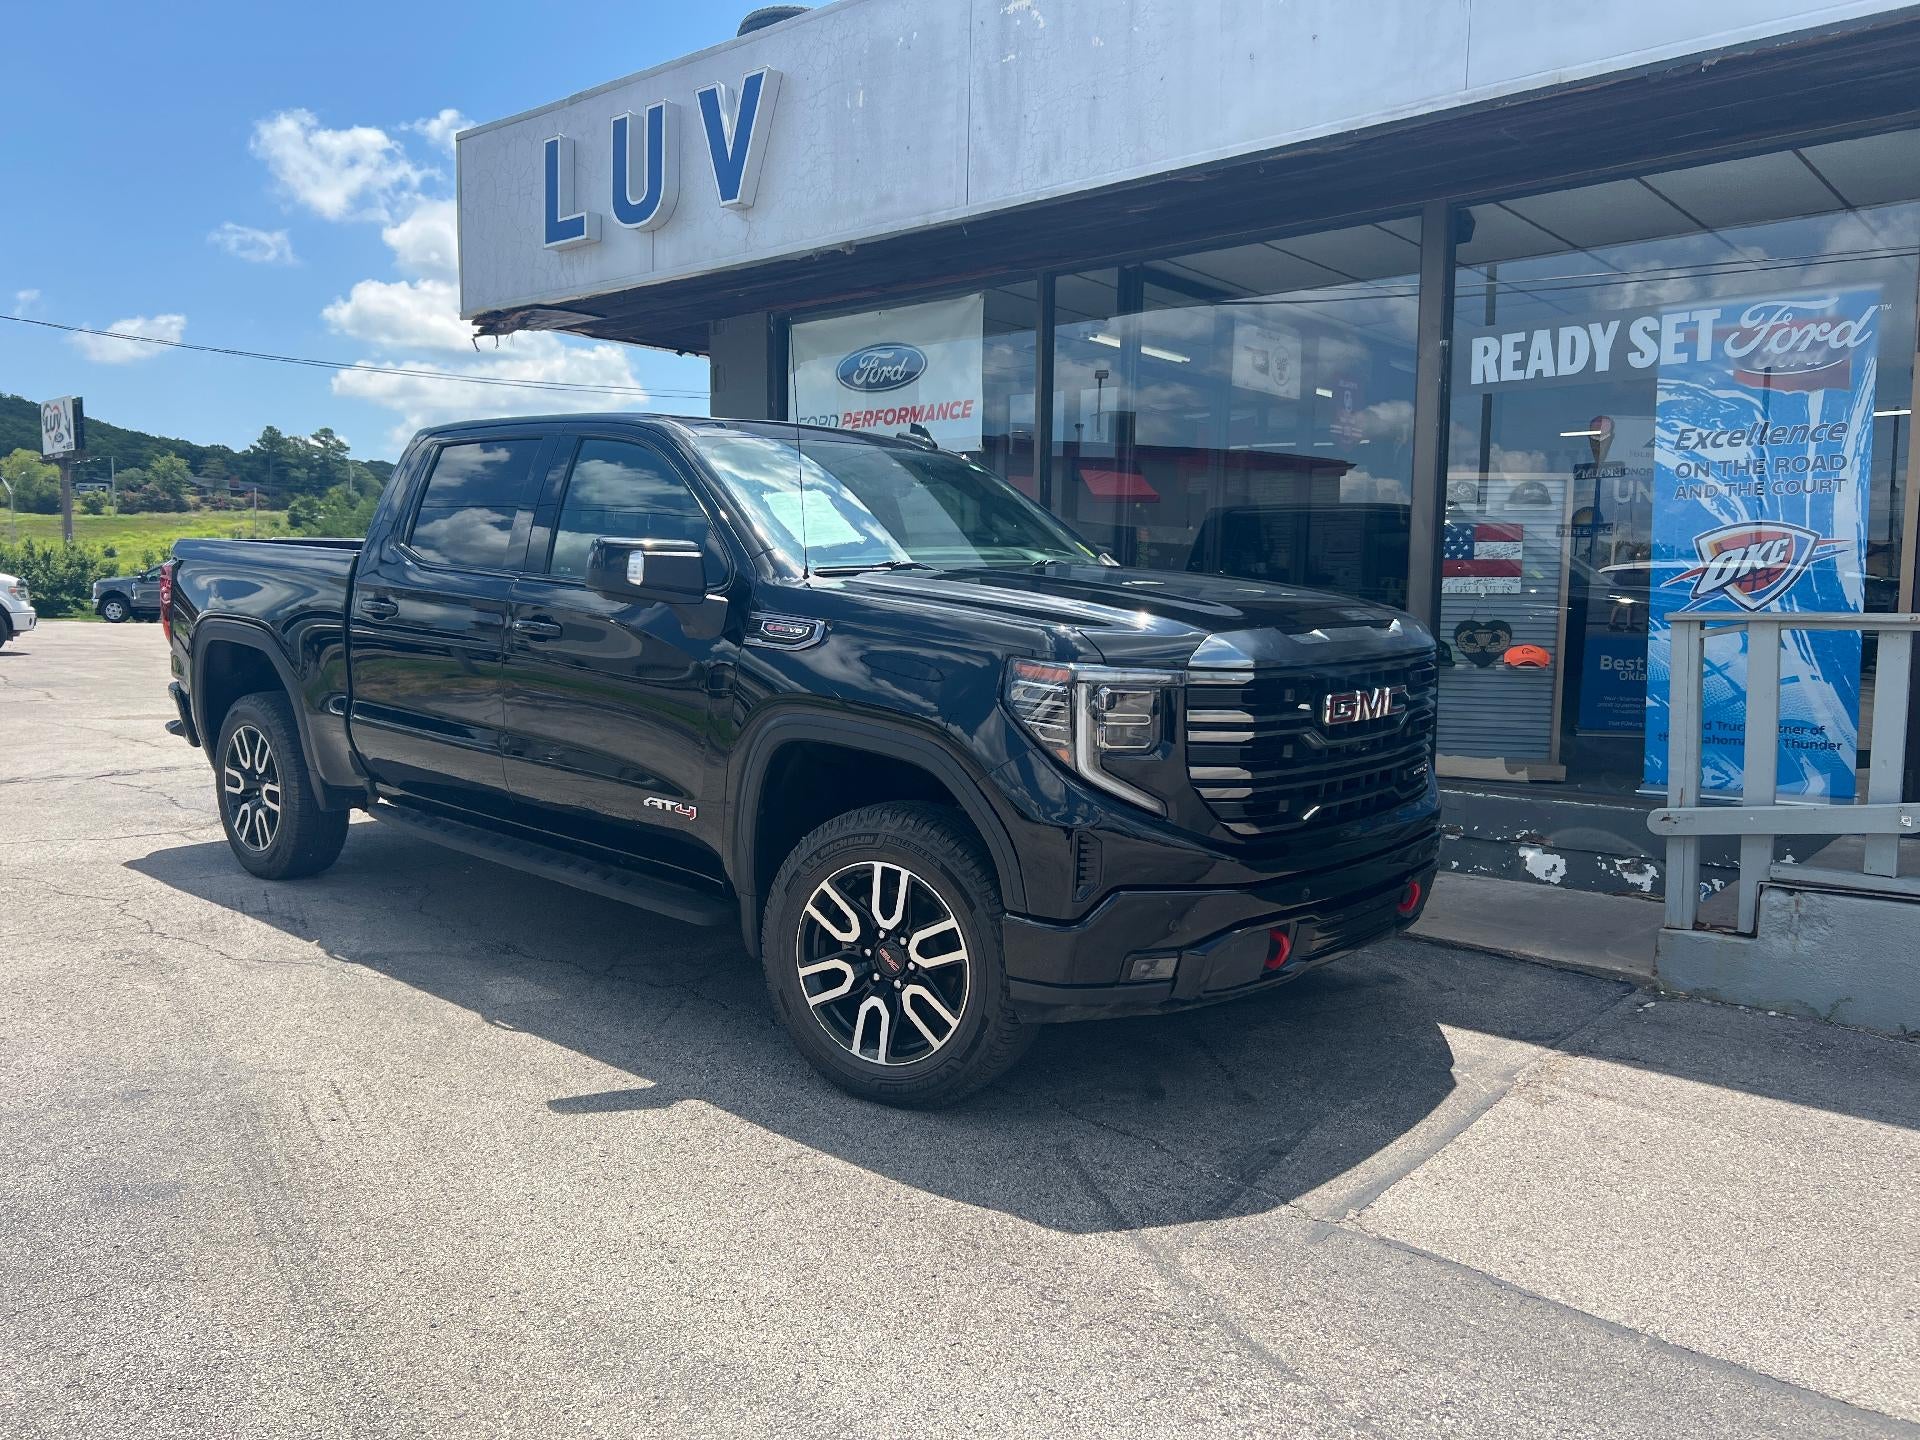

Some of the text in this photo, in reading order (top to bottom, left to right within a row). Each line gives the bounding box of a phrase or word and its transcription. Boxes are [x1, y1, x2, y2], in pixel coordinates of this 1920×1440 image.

[1471, 319, 1620, 384] READY
[1628, 308, 1721, 368] SET
[1724, 296, 1878, 358] Ford
[853, 351, 908, 384] Ford
[842, 399, 974, 429] PERFORMANCE
[1674, 421, 1848, 450] Excellence
[1674, 454, 1848, 479] ON THE ROAD
[1674, 478, 1848, 500] AND THE COURT
[1697, 537, 1791, 594] OKC
[1600, 656, 1644, 671] Best
[1323, 685, 1410, 725] GMC
[1810, 725, 1825, 735] of
[1784, 738, 1842, 751] Thunder
[643, 796, 697, 821] AT4
